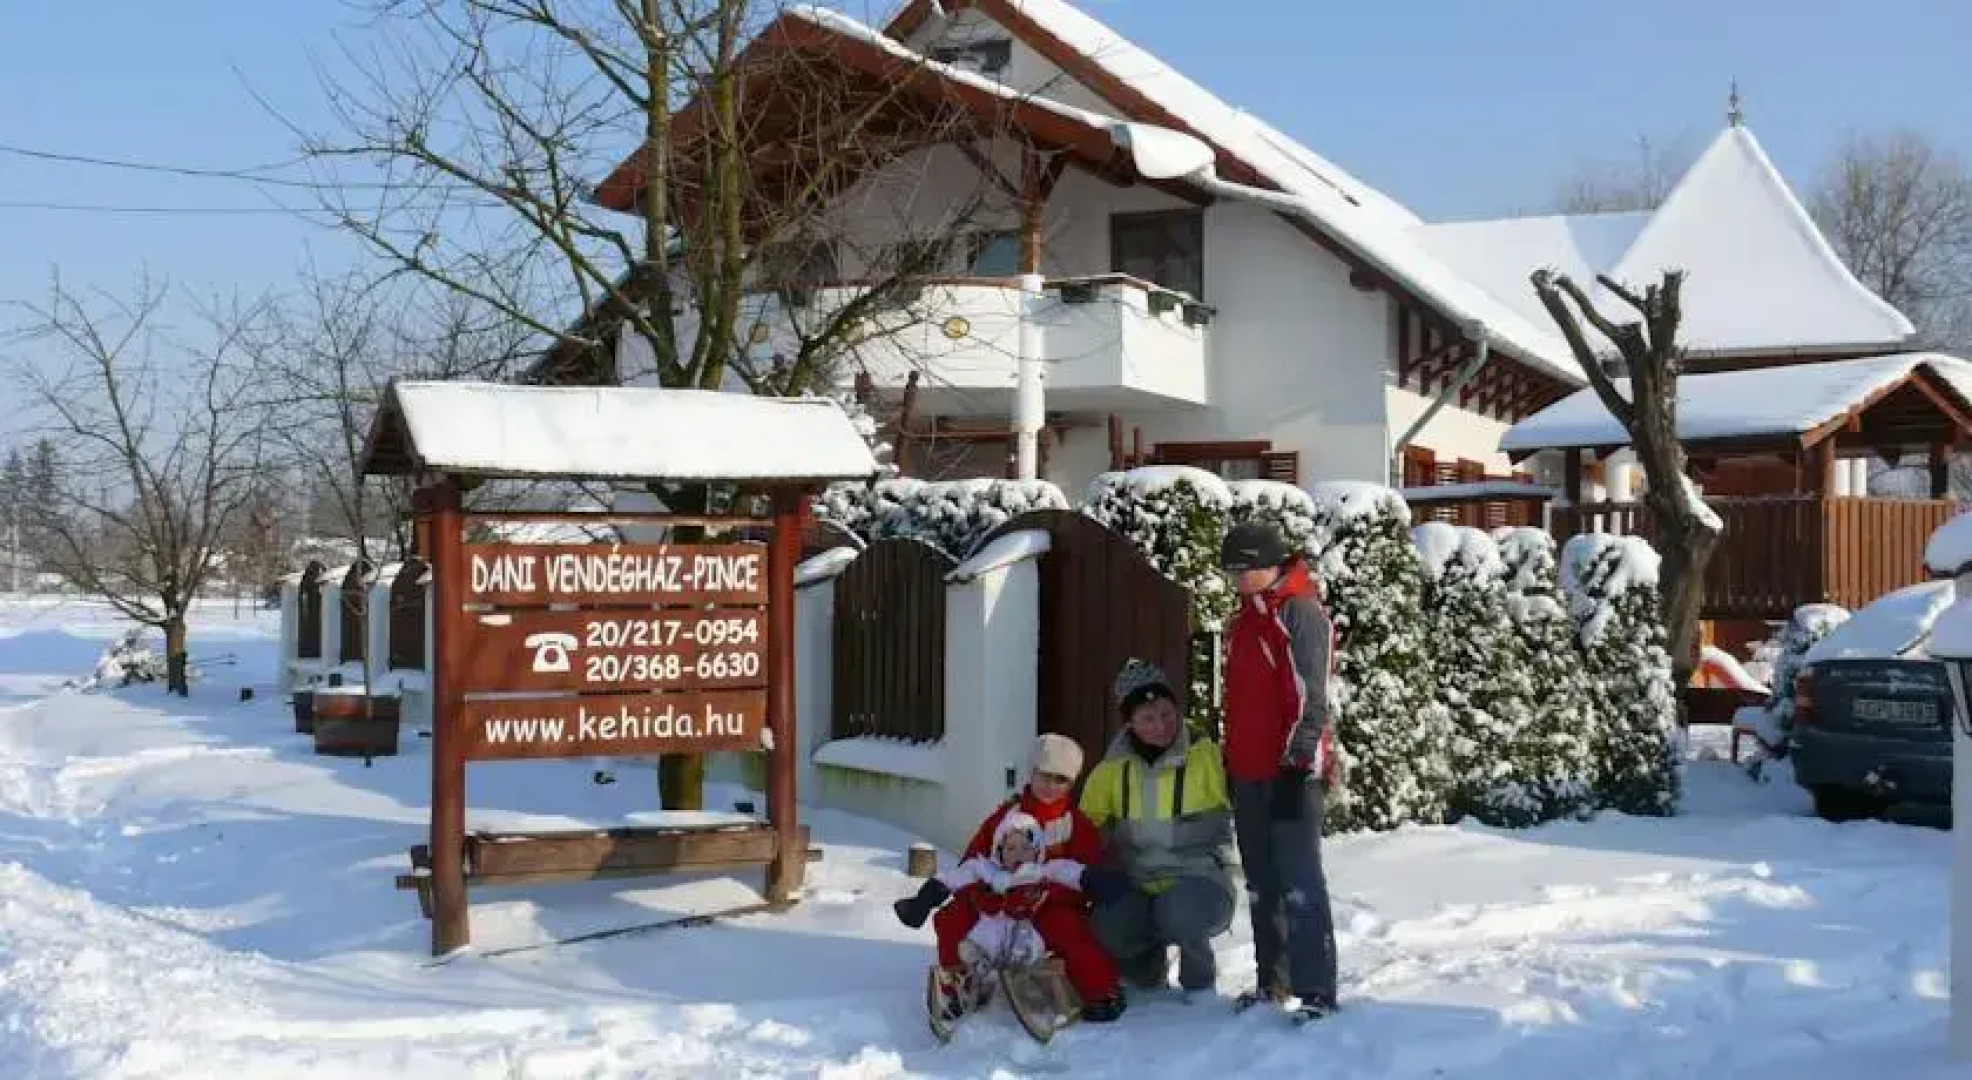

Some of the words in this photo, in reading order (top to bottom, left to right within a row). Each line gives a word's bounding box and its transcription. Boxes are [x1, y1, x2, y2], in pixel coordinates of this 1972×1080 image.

[472, 554, 536, 592] DANI
[545, 543, 759, 592] VENDÉGHÁZ-PINCE
[586, 619, 758, 647] 20/217-0954
[586, 653, 759, 682] 20/368-6630
[485, 704, 744, 743] www.kehida.hu
